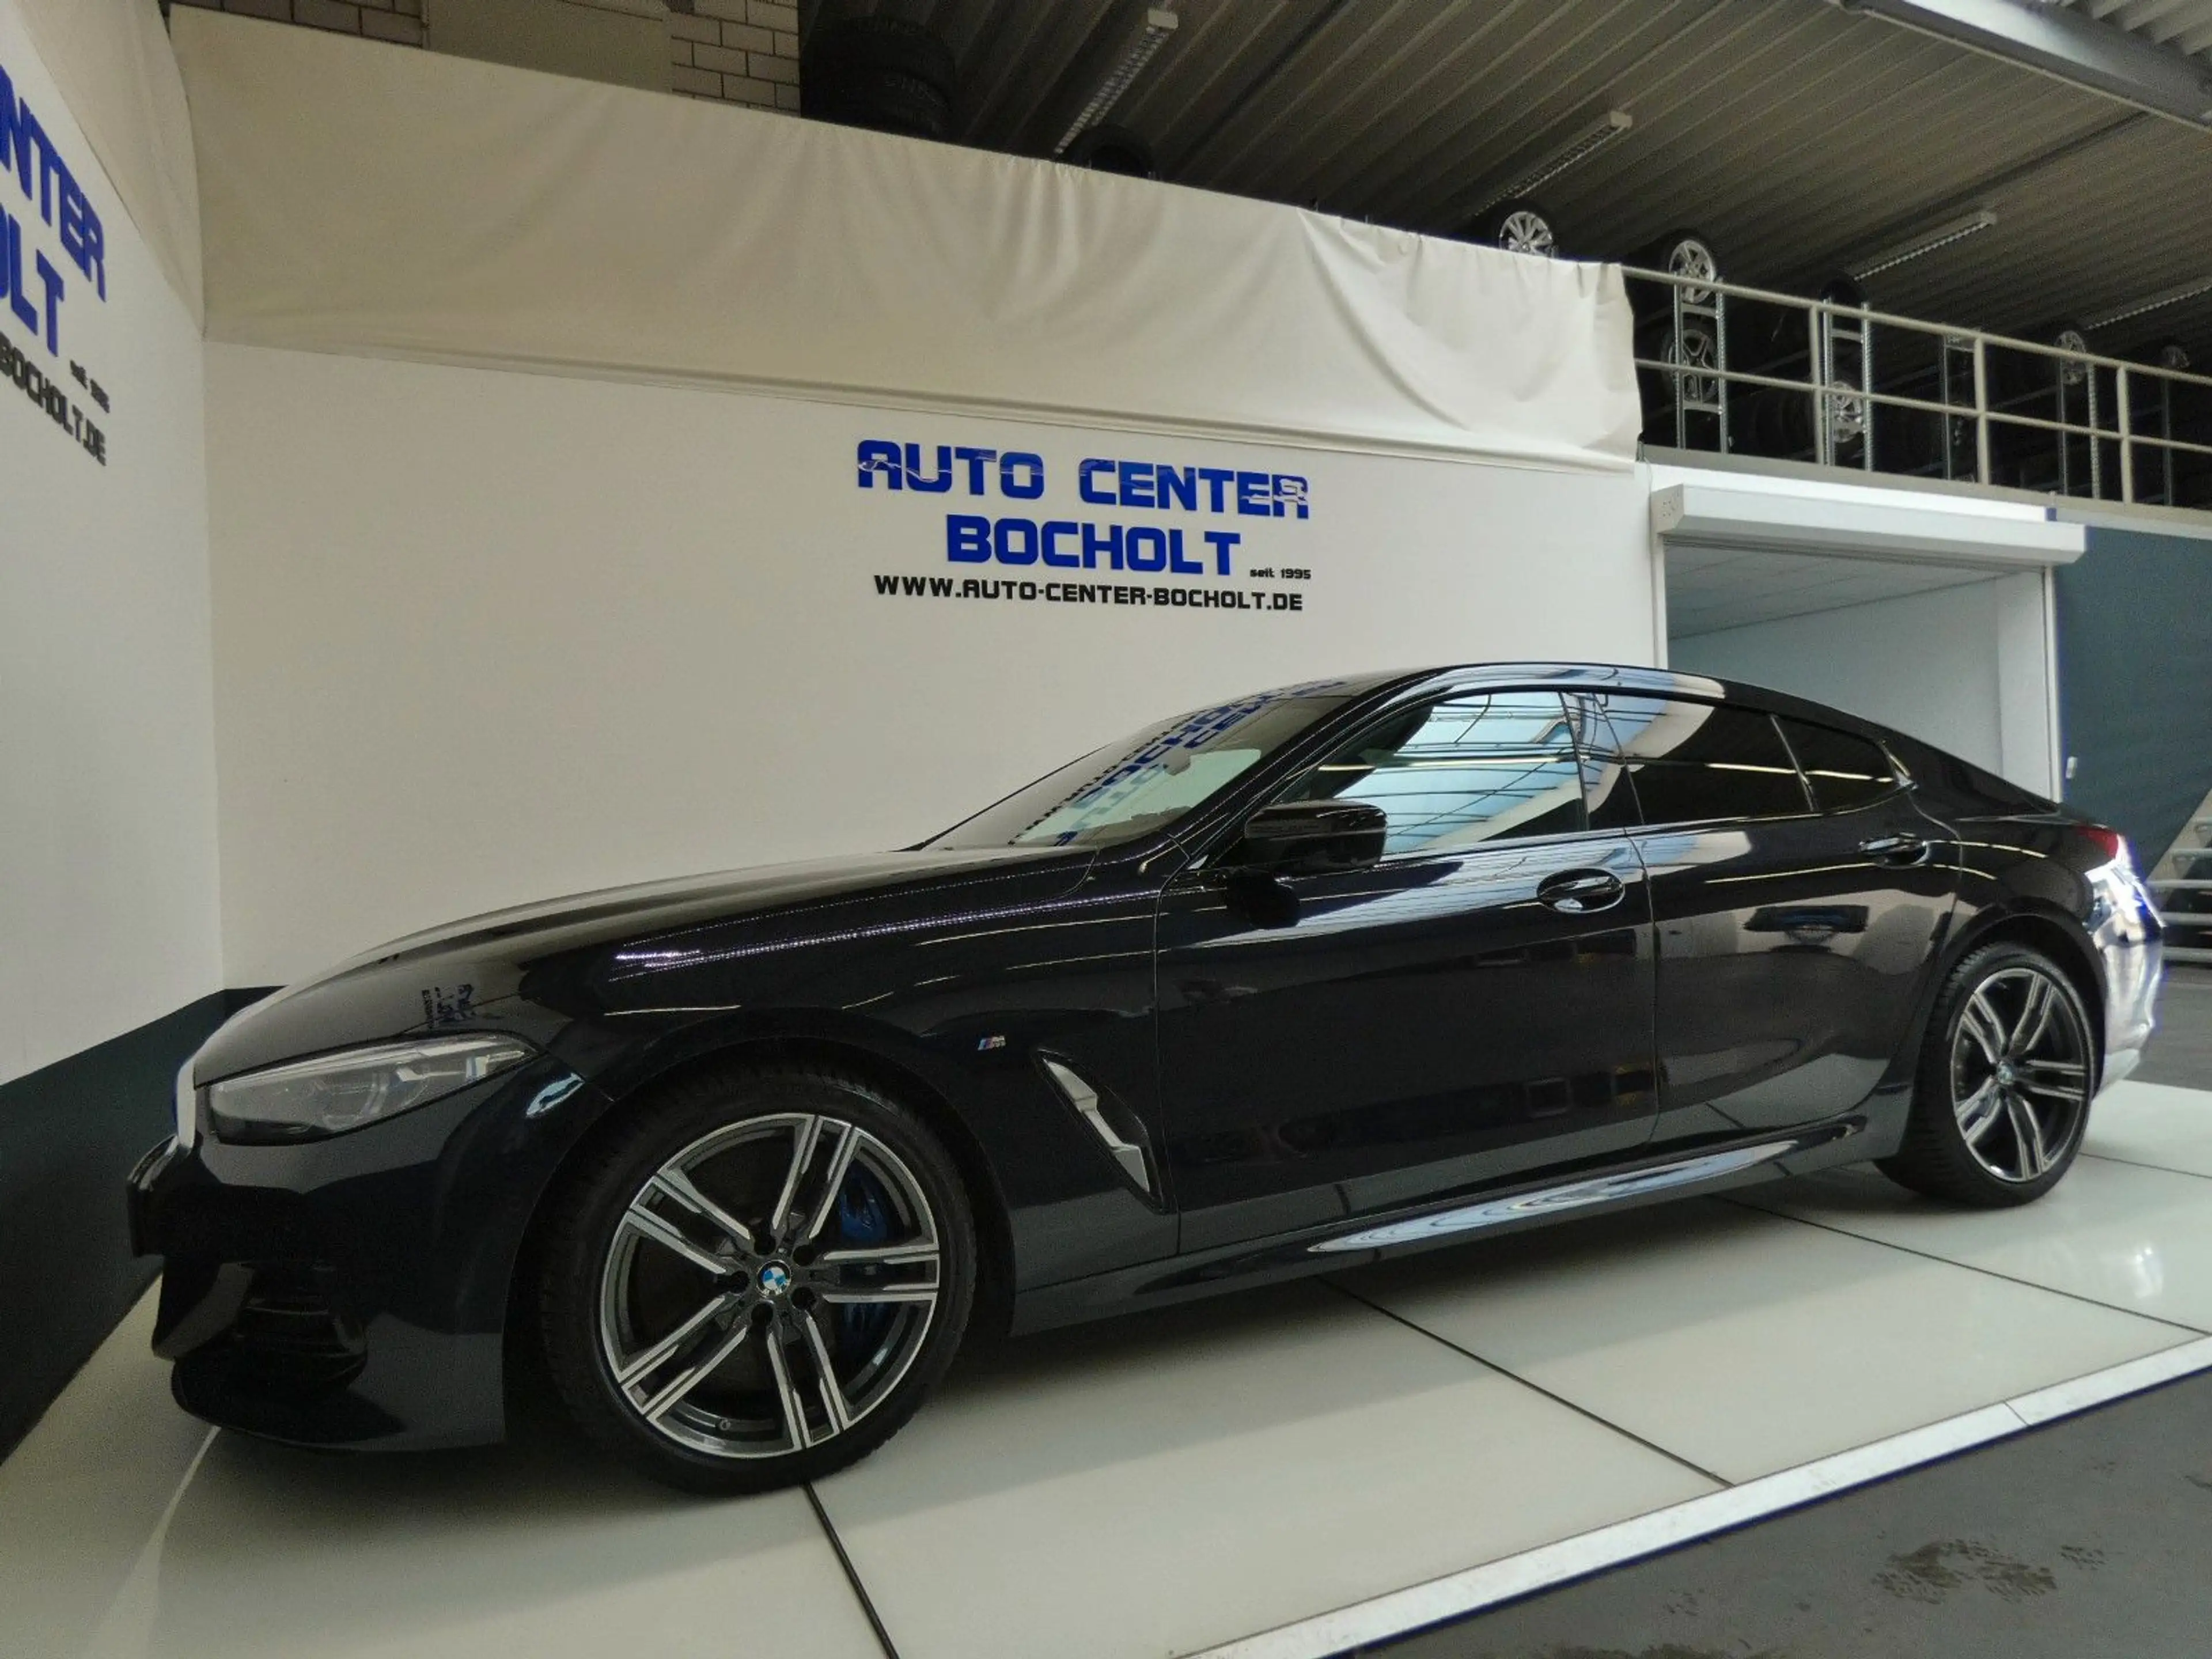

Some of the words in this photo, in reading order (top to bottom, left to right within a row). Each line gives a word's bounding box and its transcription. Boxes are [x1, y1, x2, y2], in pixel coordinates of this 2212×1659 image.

[0, 202, 64, 357] LT
[857, 440, 1044, 499] AUTO
[1079, 457, 1309, 519] CENTER
[946, 514, 1241, 575] BOCHOLT
[1249, 567, 1275, 578] seit
[1280, 568, 1312, 579] 1995
[874, 575, 1303, 611] WWW.AUTO-CENTER-BOCHOLT.DE
